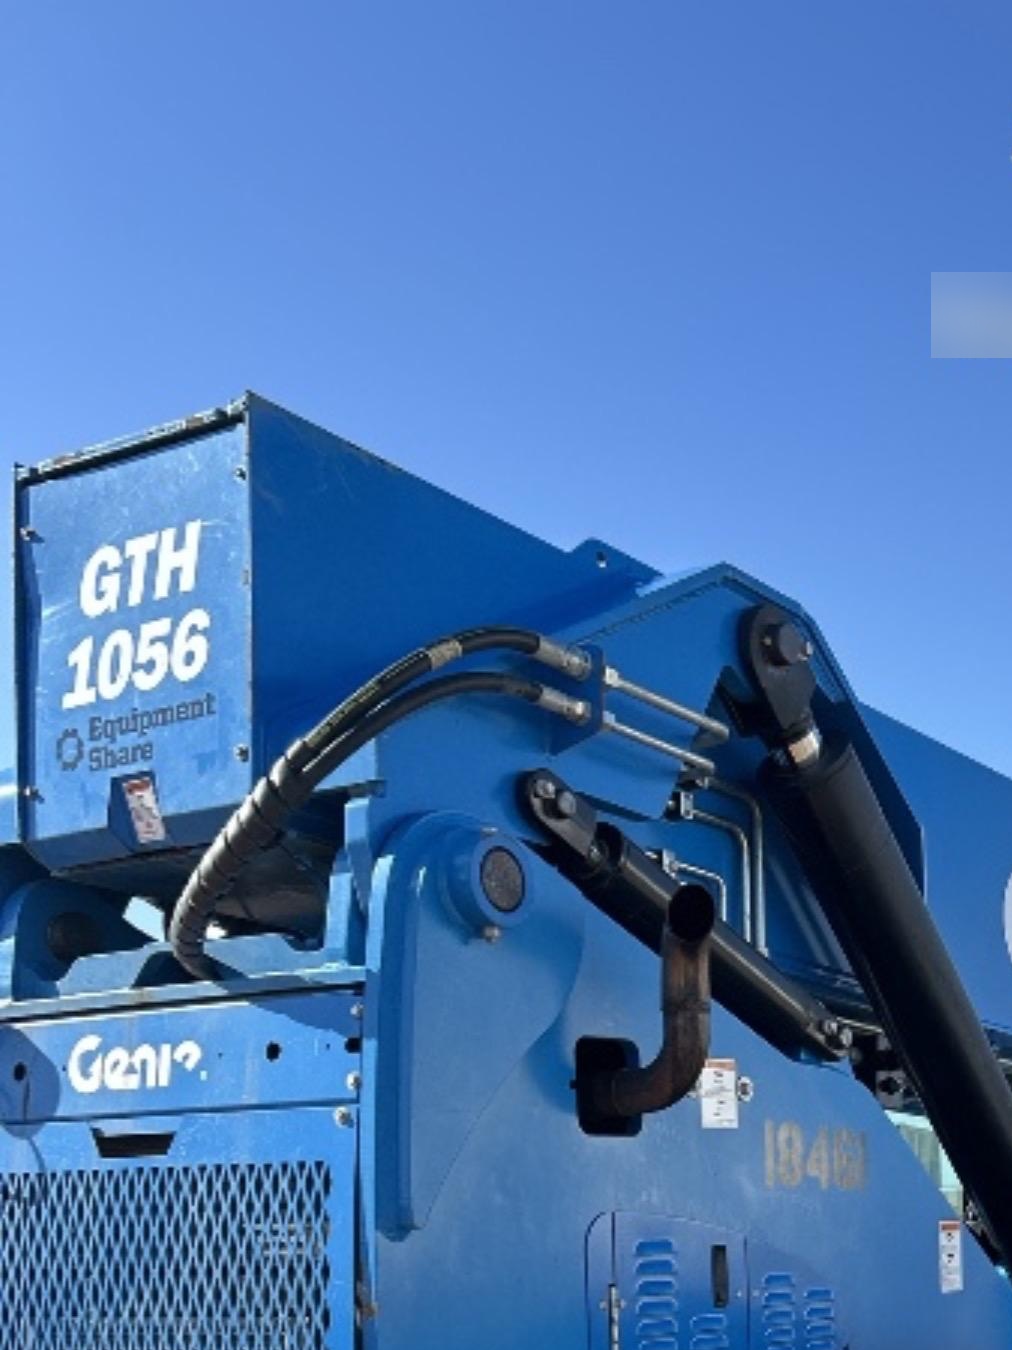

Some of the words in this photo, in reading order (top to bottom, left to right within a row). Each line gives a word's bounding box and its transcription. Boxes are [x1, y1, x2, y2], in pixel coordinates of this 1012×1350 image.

[79, 518, 200, 618] GTH
[62, 608, 211, 710] 1056
[88, 692, 216, 744] Equipment
[88, 741, 154, 773] Share
